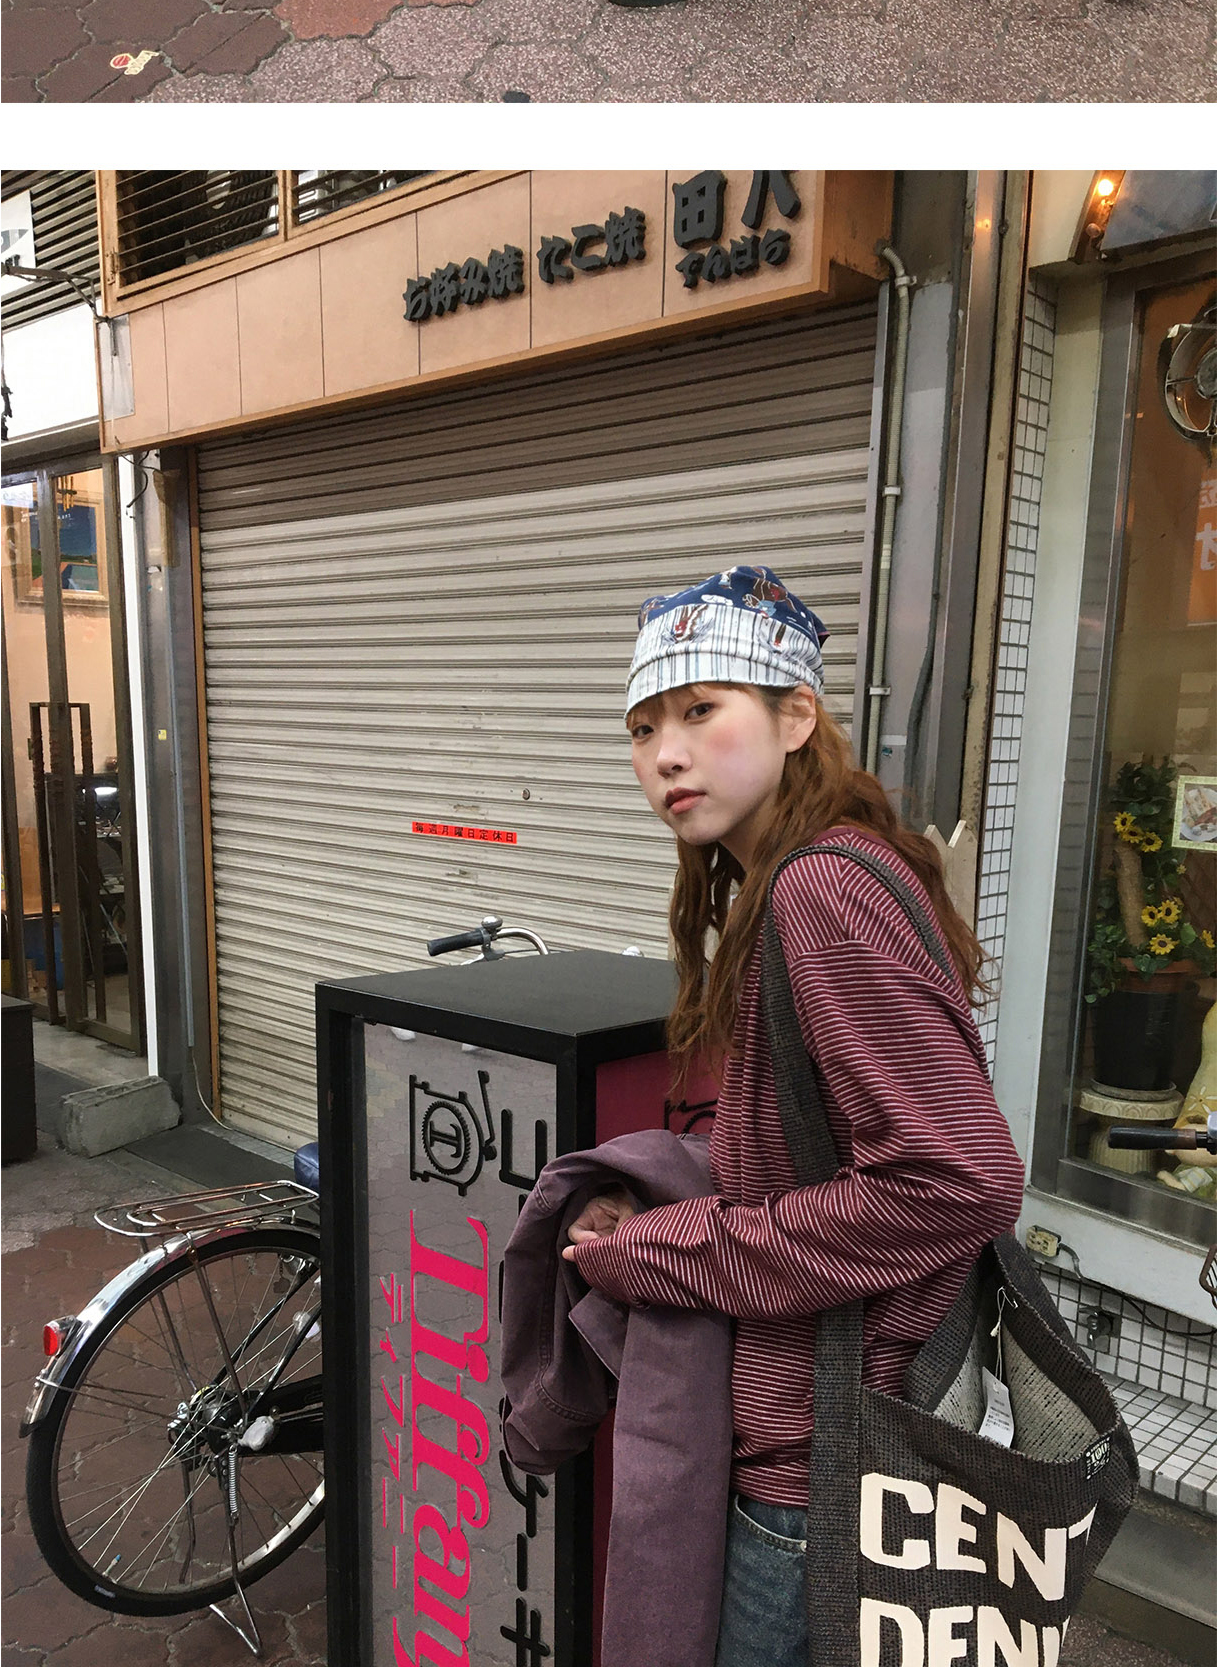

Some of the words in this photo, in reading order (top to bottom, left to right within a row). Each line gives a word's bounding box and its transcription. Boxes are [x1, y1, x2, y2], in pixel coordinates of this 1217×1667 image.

[415, 822, 514, 842] 毎週月曜日定休日
